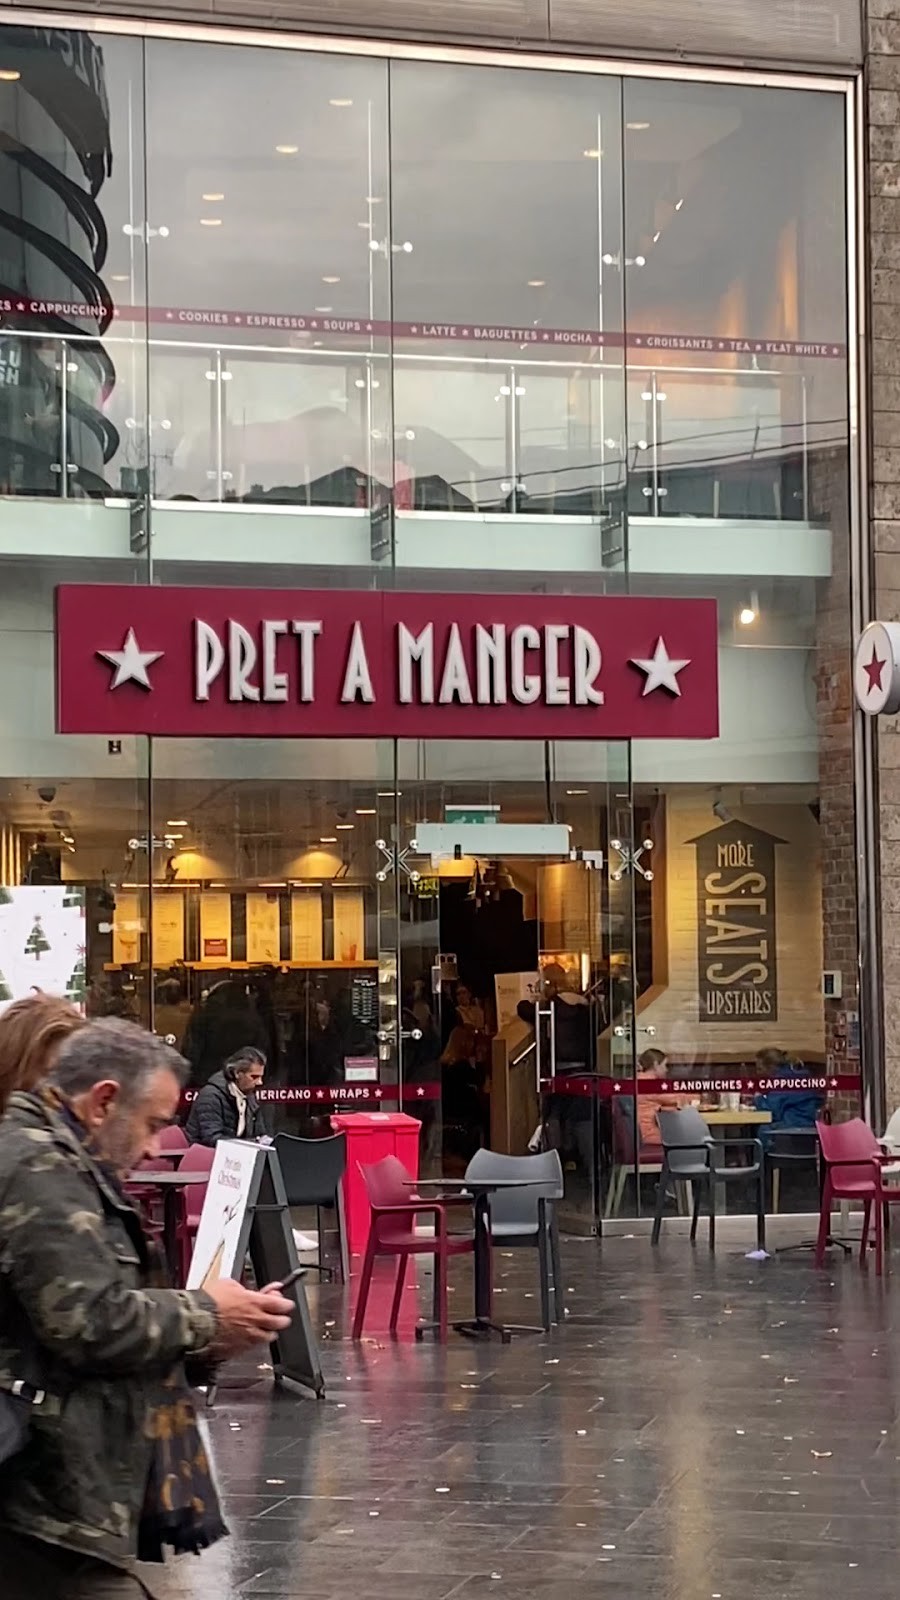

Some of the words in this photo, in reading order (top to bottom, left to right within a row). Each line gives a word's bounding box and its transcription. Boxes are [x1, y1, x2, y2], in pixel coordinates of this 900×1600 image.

[30, 302, 107, 316] CAPPUCCINO
[178, 311, 228, 324] COOKIES
[247, 315, 306, 329] ESPRESSO
[323, 319, 361, 331] SOUPS
[422, 325, 457, 337] LATTE
[473, 328, 537, 341] BAGUETTES
[554, 332, 592, 343] MOCHA
[646, 337, 713, 349] CROISSANTS
[730, 341, 751, 351] TEA
[766, 343, 792, 353] FLAT
[795, 344, 828, 354] WHITE
[193, 617, 323, 702] PRET
[341, 620, 376, 703] A
[396, 621, 604, 705] MANGER
[717, 842, 755, 868] MORE
[704, 872, 769, 985] SEATS
[706, 990, 772, 1015] UPSTAIRS
[256, 1089, 311, 1100] ERICANO
[329, 1088, 370, 1099] WRAPS
[673, 1080, 742, 1091] SANDWICHES
[758, 1078, 826, 1089] CAPPUCCINO
